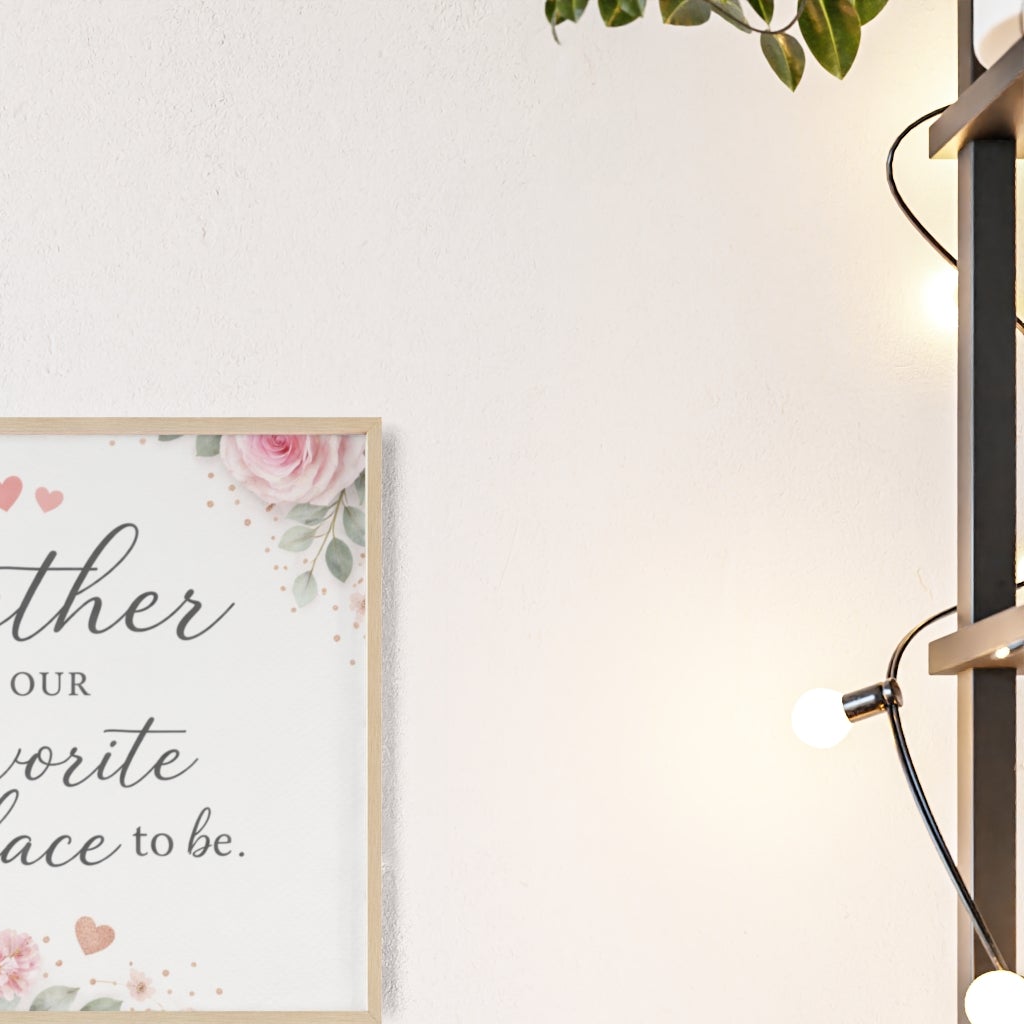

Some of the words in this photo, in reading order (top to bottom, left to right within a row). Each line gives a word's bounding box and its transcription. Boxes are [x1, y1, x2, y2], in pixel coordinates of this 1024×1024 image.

[10, 671, 91, 697] OUR
[132, 826, 174, 857] to
[187, 807, 245, 857] be.
